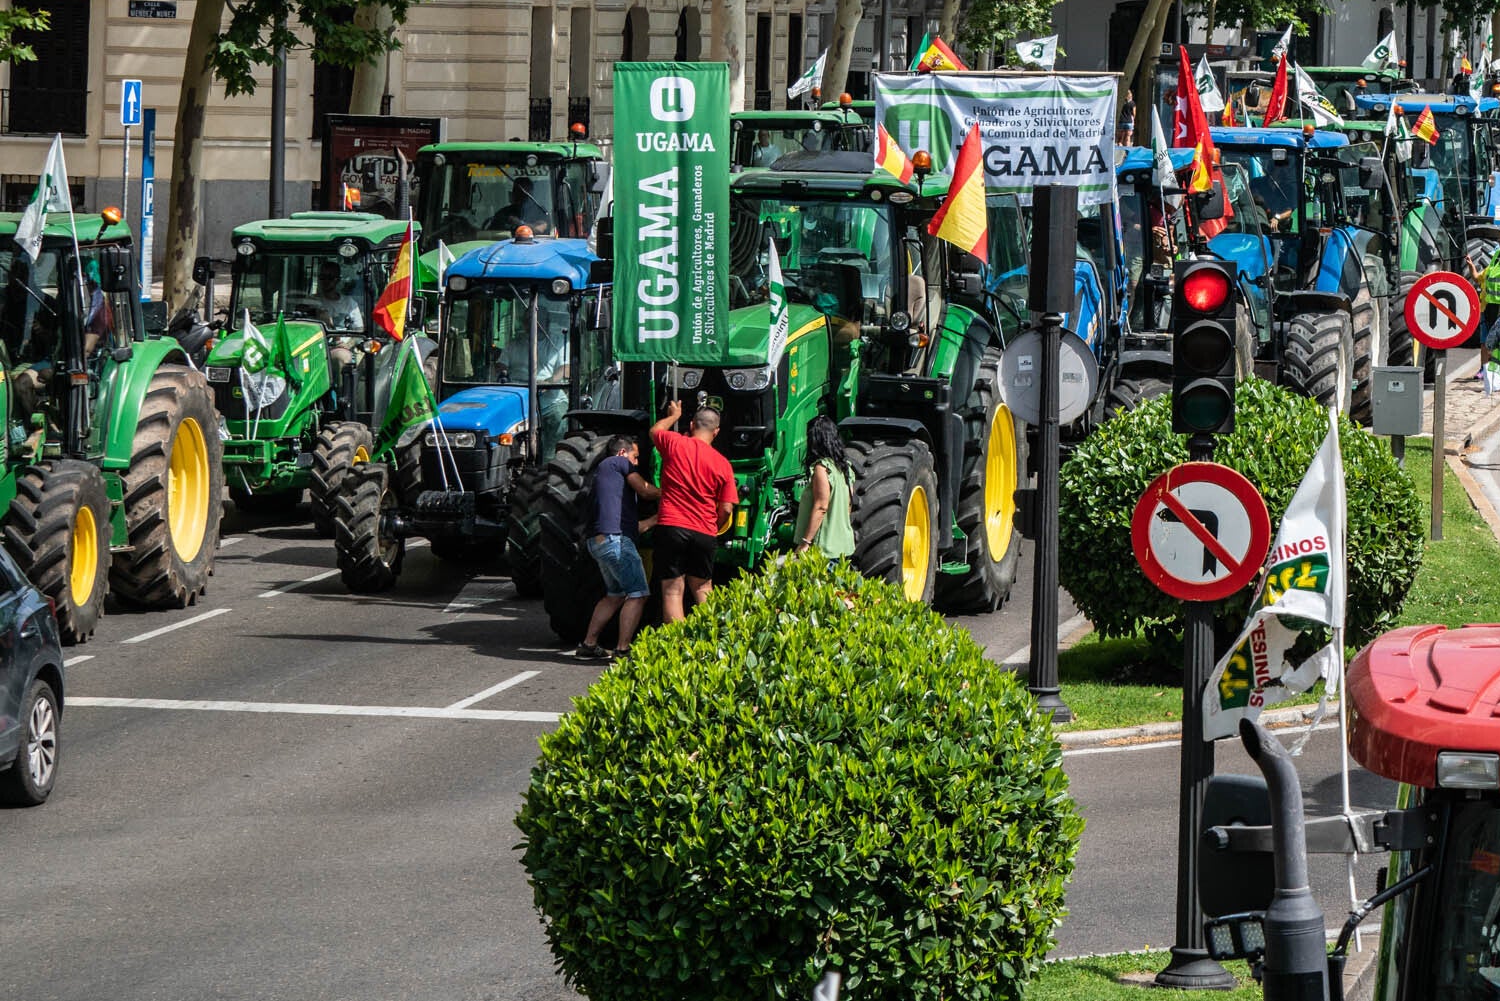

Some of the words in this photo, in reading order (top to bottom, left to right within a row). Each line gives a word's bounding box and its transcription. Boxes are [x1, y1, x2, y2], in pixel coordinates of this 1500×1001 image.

[972, 105, 1005, 117] Unión
[1007, 106, 1021, 117] de
[1023, 105, 1094, 118] Agricultores,
[1033, 116, 1101, 127] Silvicultores
[636, 132, 715, 152] UGAMA
[987, 128, 1050, 138] Comunidad
[1056, 128, 1066, 138] de
[1068, 126, 1106, 138] Madrid
[956, 144, 1109, 177] GAMA
[691, 164, 703, 222] Ganaderos
[704, 211, 715, 251] Madrid
[638, 167, 680, 344] UGAMA
[691, 226, 704, 293] Agricultores,
[704, 254, 715, 267] de
[692, 296, 703, 309] de
[704, 269, 716, 335] Silvicultores
[691, 312, 703, 345] Unión
